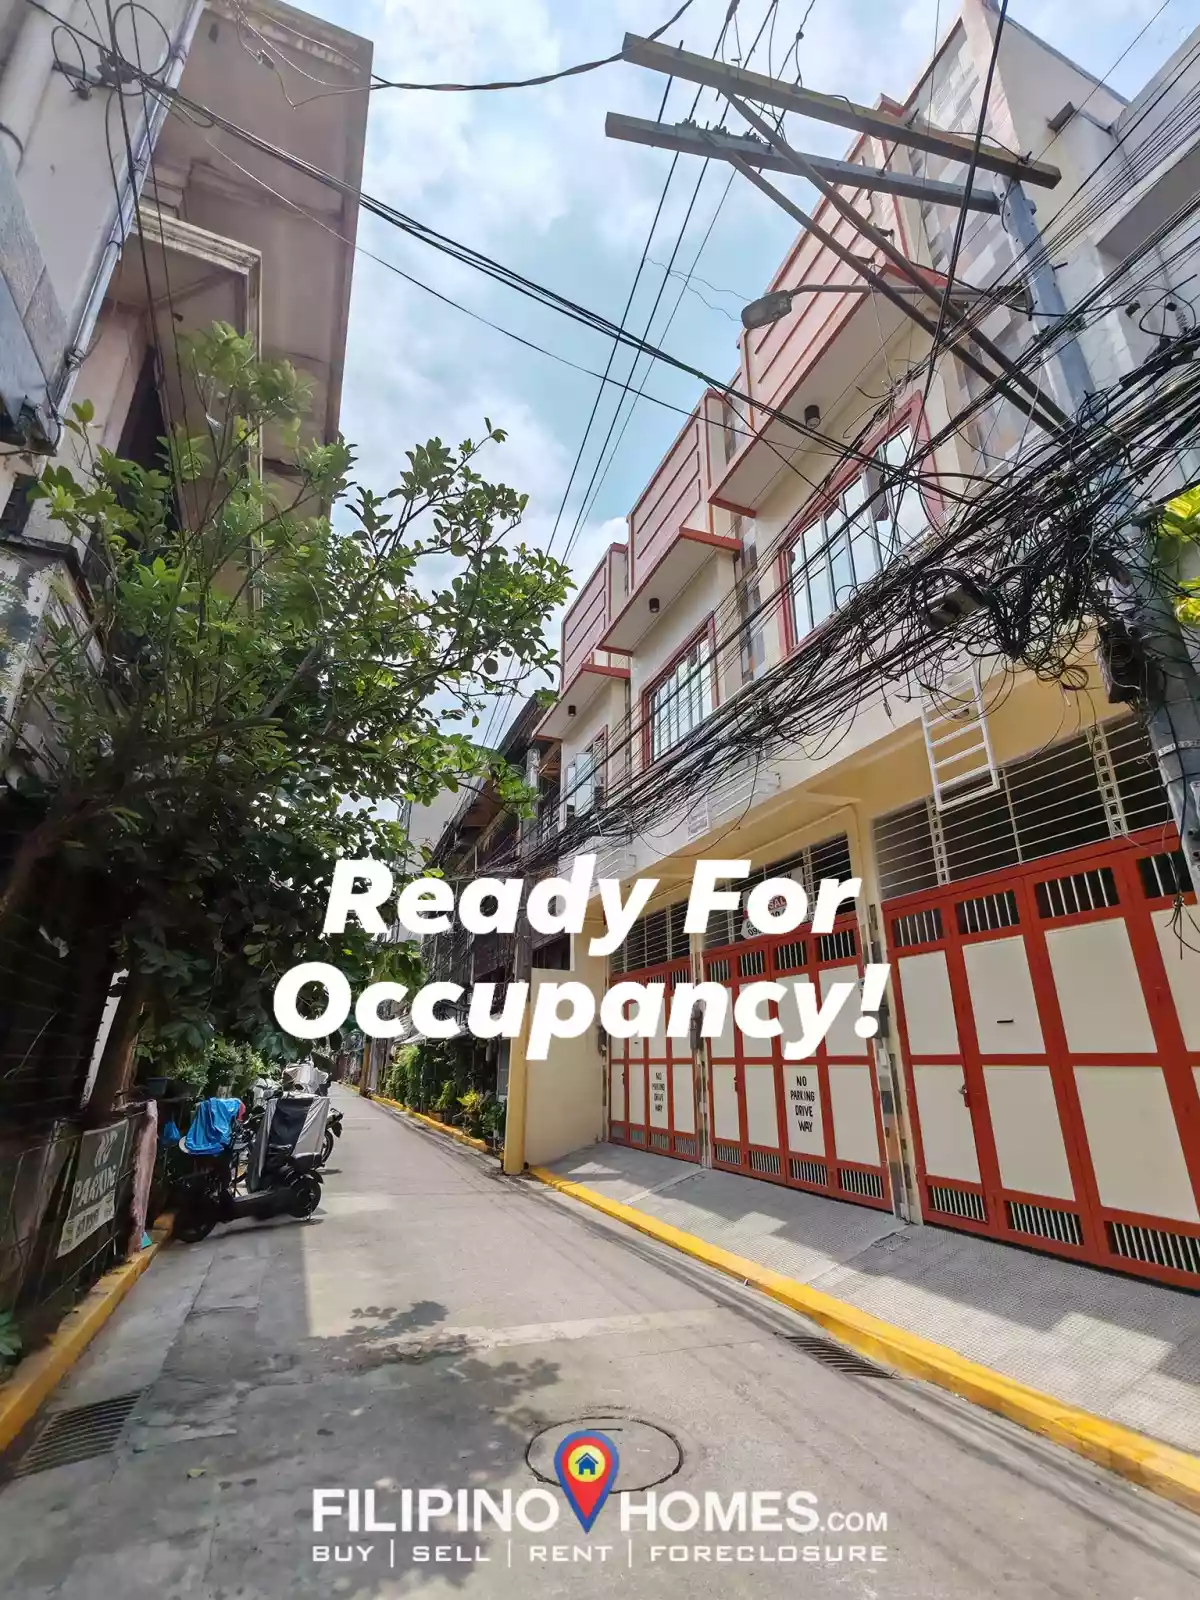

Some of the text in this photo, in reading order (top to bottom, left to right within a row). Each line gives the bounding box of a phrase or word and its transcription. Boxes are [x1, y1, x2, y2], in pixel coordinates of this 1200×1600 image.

[796, 1075, 807, 1087] NO
[790, 1090, 815, 1102] PARKING
[795, 1105, 813, 1117] DRIVE
[798, 1120, 813, 1133] WAY
